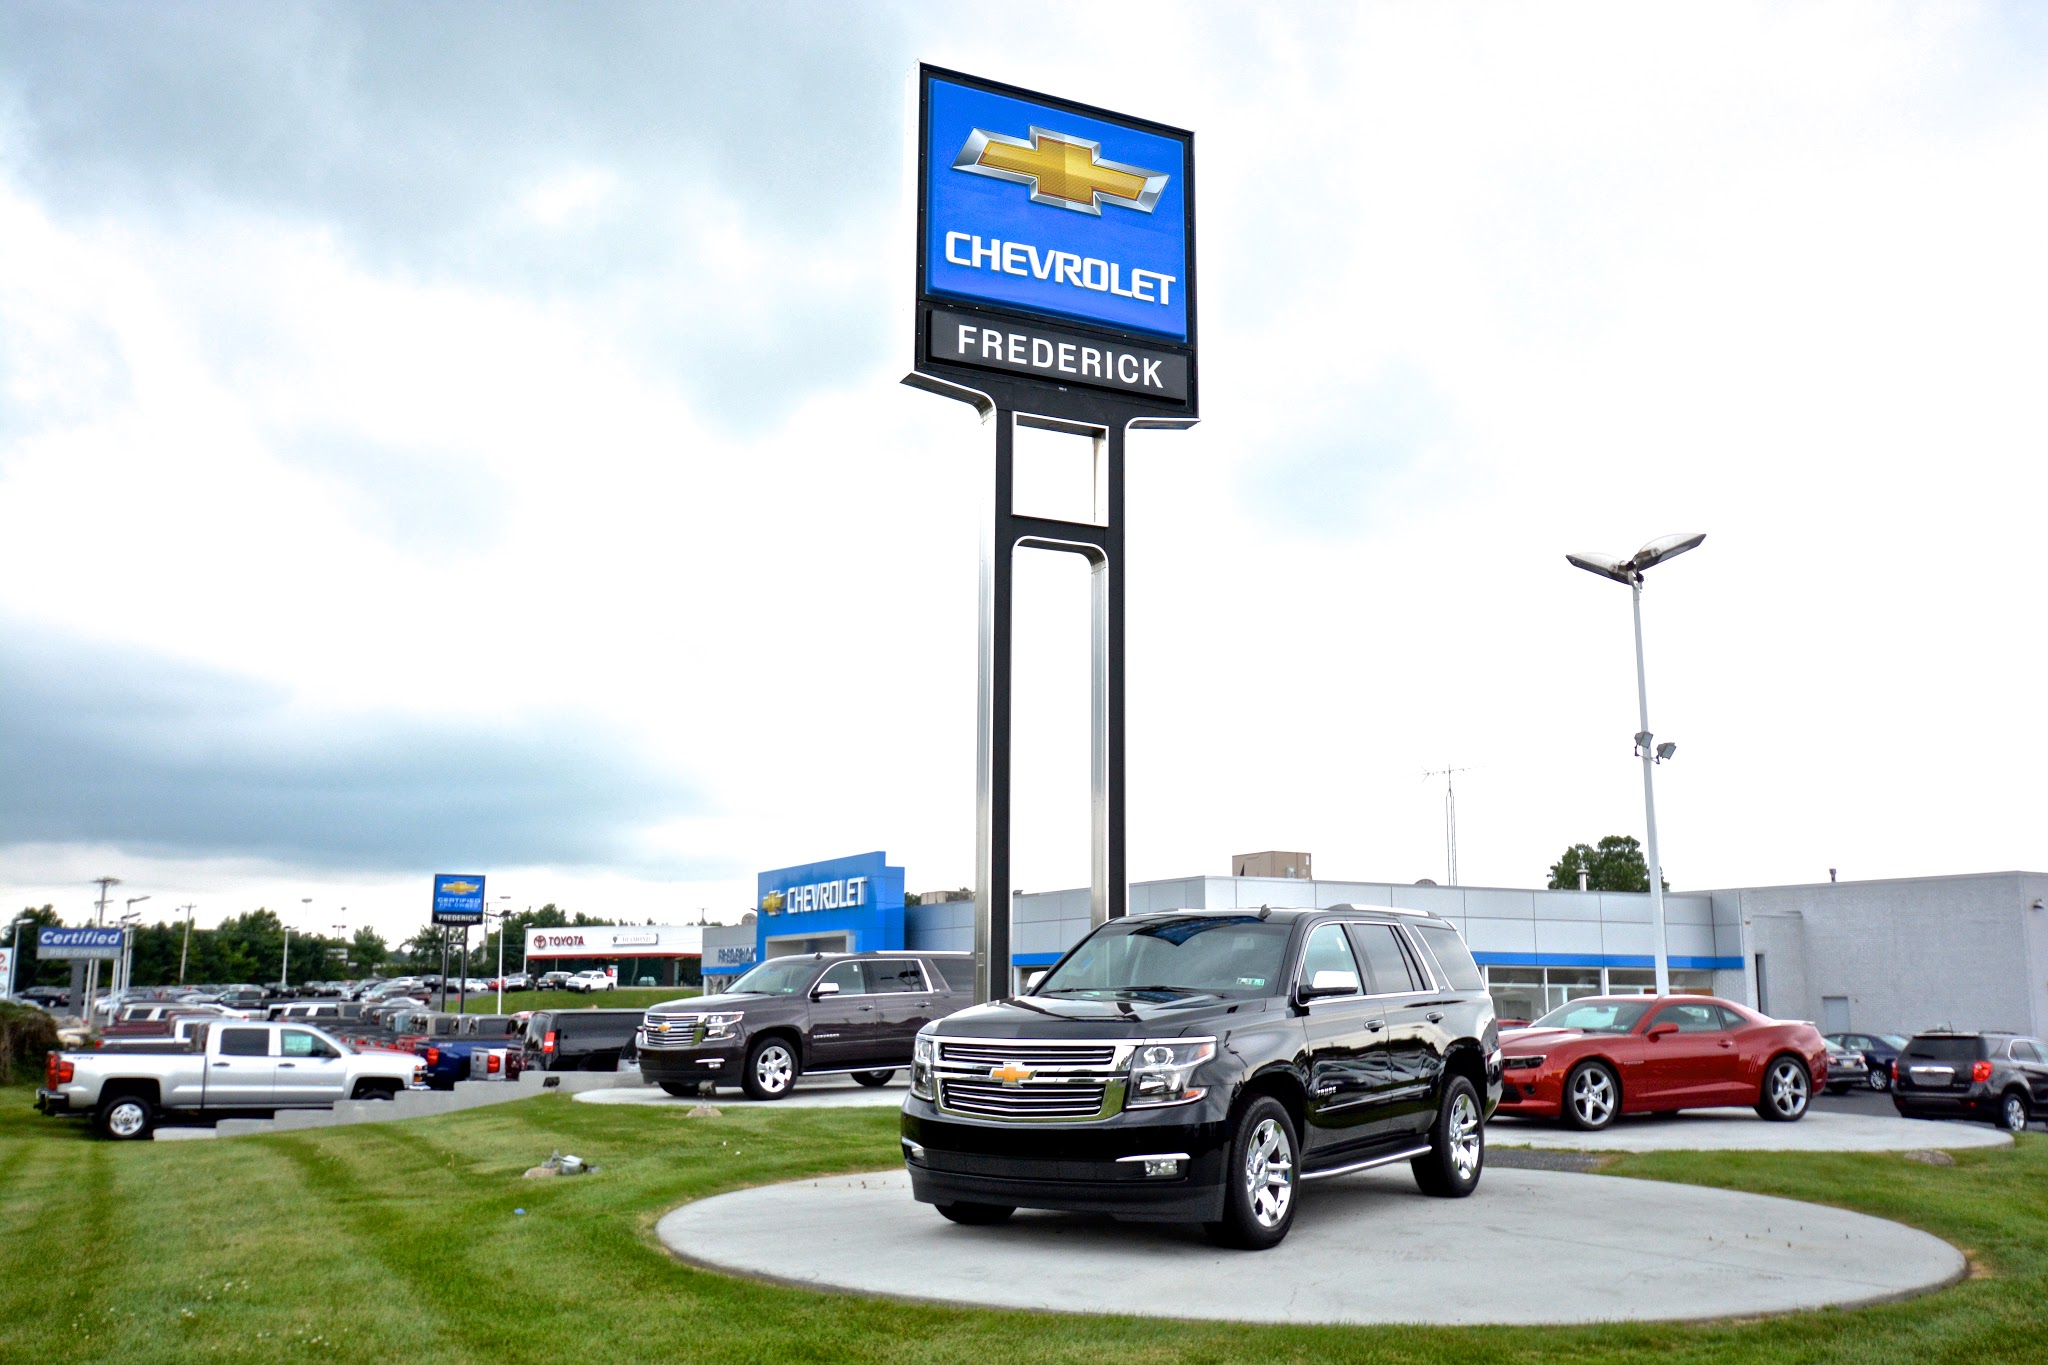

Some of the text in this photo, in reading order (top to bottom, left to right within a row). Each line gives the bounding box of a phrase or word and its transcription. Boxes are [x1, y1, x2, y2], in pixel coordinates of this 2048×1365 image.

[945, 230, 1176, 305] CHEVROLET
[957, 323, 1164, 389] FREDERICK
[787, 876, 867, 914] CHEVROLET
[438, 914, 478, 922] FREDERICK
[40, 931, 120, 945] Certified
[548, 935, 585, 946] TOYOTA
